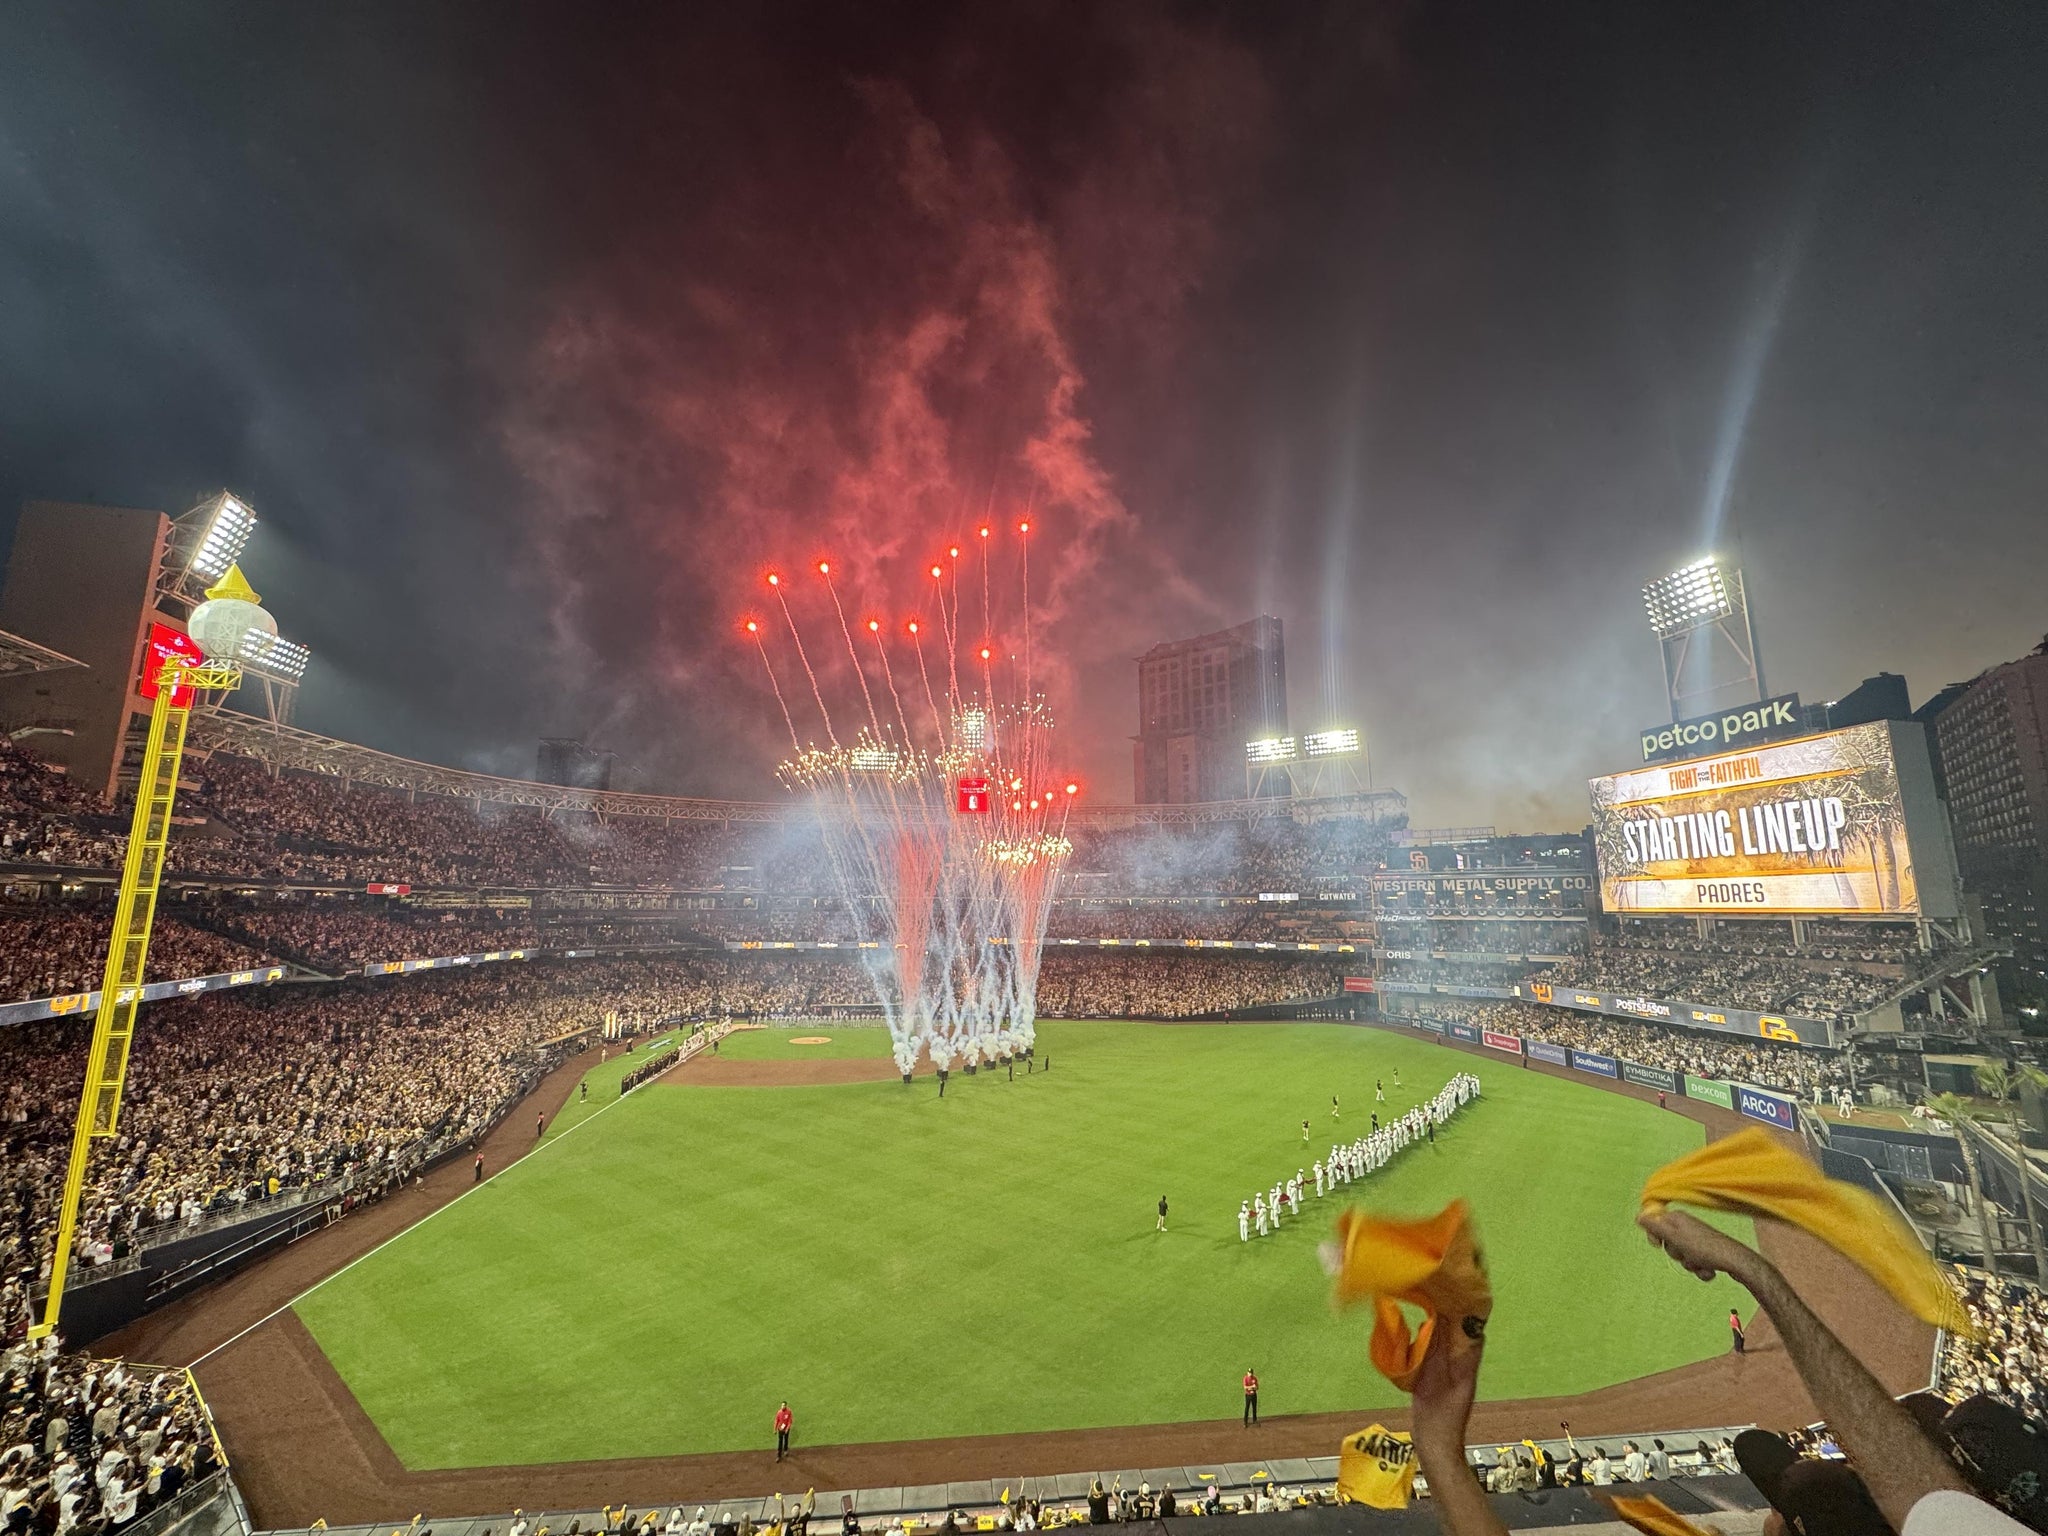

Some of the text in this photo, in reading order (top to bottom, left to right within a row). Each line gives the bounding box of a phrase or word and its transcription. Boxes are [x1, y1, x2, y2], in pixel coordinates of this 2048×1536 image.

[1641, 700, 1797, 760] petco park
[1668, 767, 1698, 791] FIGHT
[1709, 756, 1763, 785] FAITHFUL
[1622, 796, 1845, 863] STARTING LINEUP
[1373, 877, 1592, 892] WESTERN METAL SUPPLY CO.
[1697, 882, 1765, 903] PADRES
[1319, 892, 1357, 901] CUTWATER
[1386, 951, 1411, 959] ORIS
[1615, 998, 1671, 1017] POSTSEASON
[1575, 1055, 1609, 1071] Southwest
[1742, 1094, 1777, 1118] ARCO
